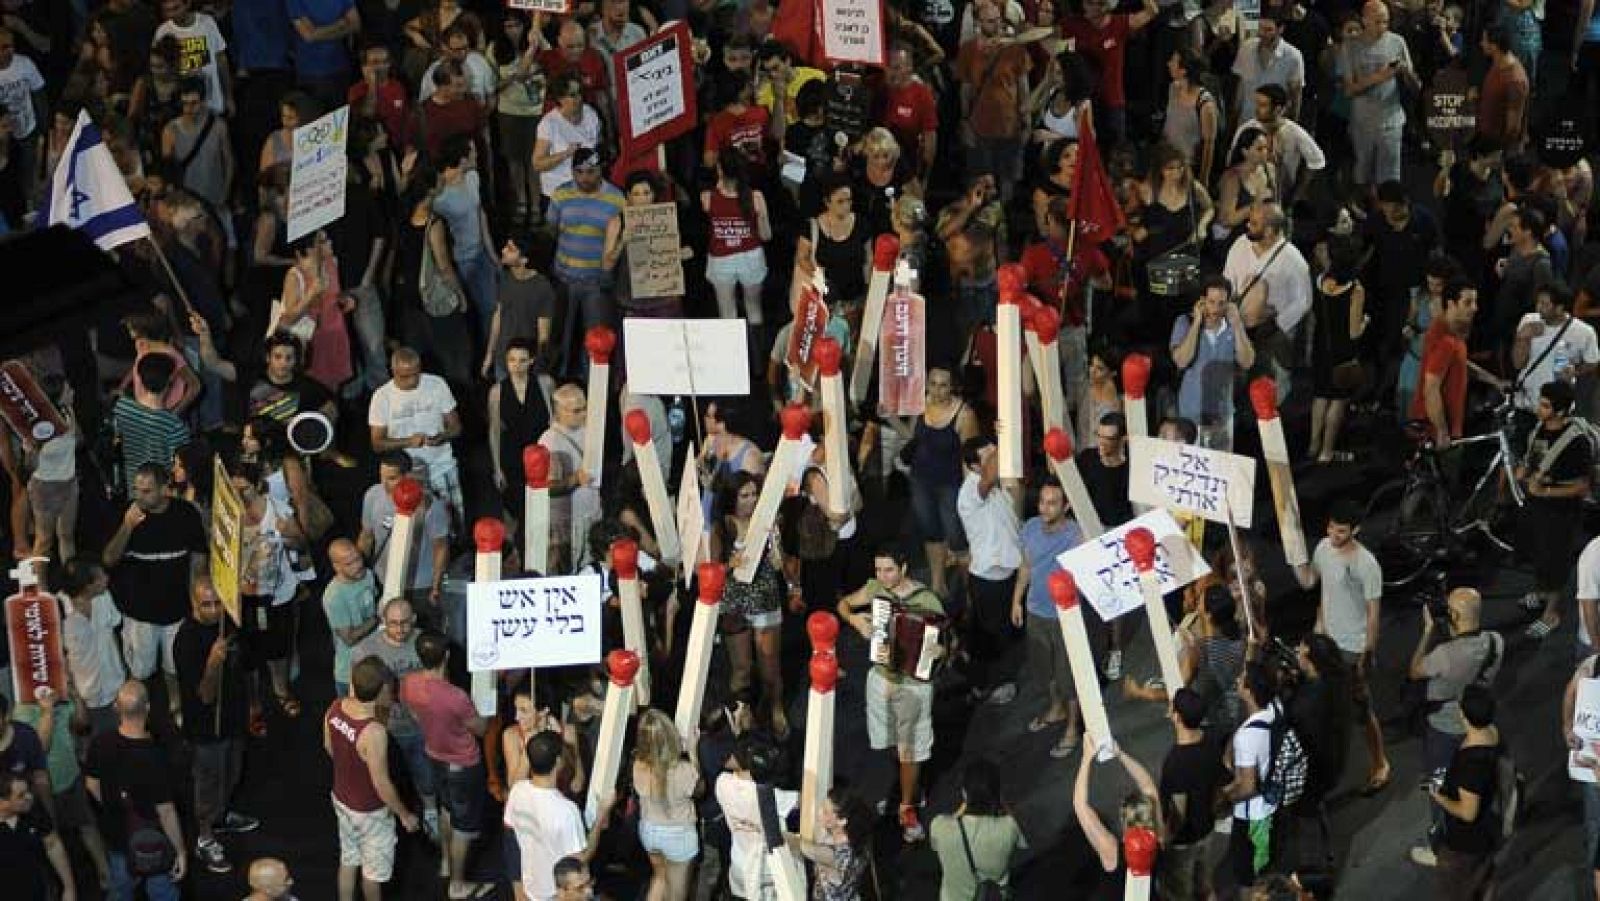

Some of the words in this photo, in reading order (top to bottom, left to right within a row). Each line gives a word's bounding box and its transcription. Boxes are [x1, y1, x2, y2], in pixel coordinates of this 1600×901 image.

[1432, 94, 1466, 108] STOP
[1179, 446, 1209, 472] אל
[1167, 486, 1218, 511] אותי
[499, 588, 537, 609] אש
[544, 585, 578, 614] אין
[491, 616, 538, 644] עשן
[545, 608, 585, 635] בלי
